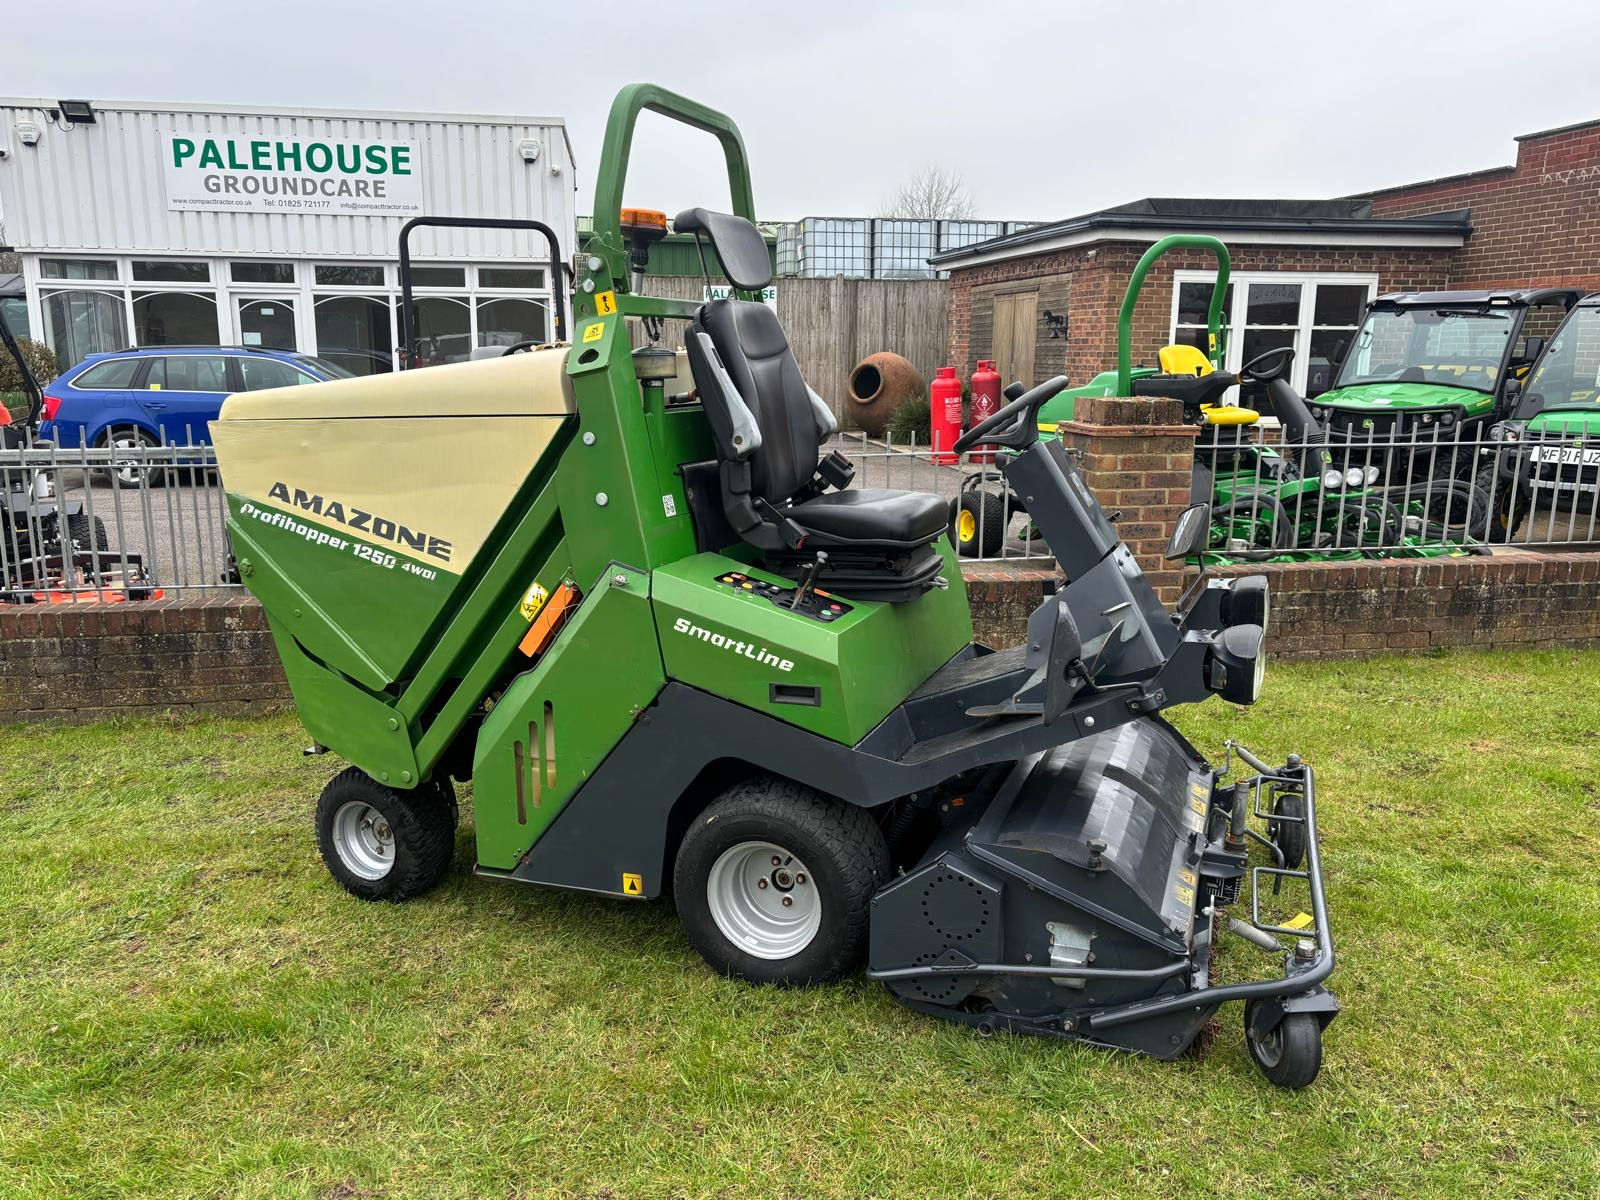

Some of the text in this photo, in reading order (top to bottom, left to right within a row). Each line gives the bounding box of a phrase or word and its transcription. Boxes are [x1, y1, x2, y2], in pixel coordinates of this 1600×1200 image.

[172, 138, 412, 175] PALEHOUSE
[172, 198, 419, 211] www.compacttractor.co.uk Tel: 01825 721177 info@compacttractor.co.uk
[204, 174, 386, 198] GROUNDCARE
[240, 503, 349, 551] Profihopper
[352, 543, 396, 569] 1250
[268, 481, 452, 562] AMAZONE
[673, 617, 795, 672] SmartLine
